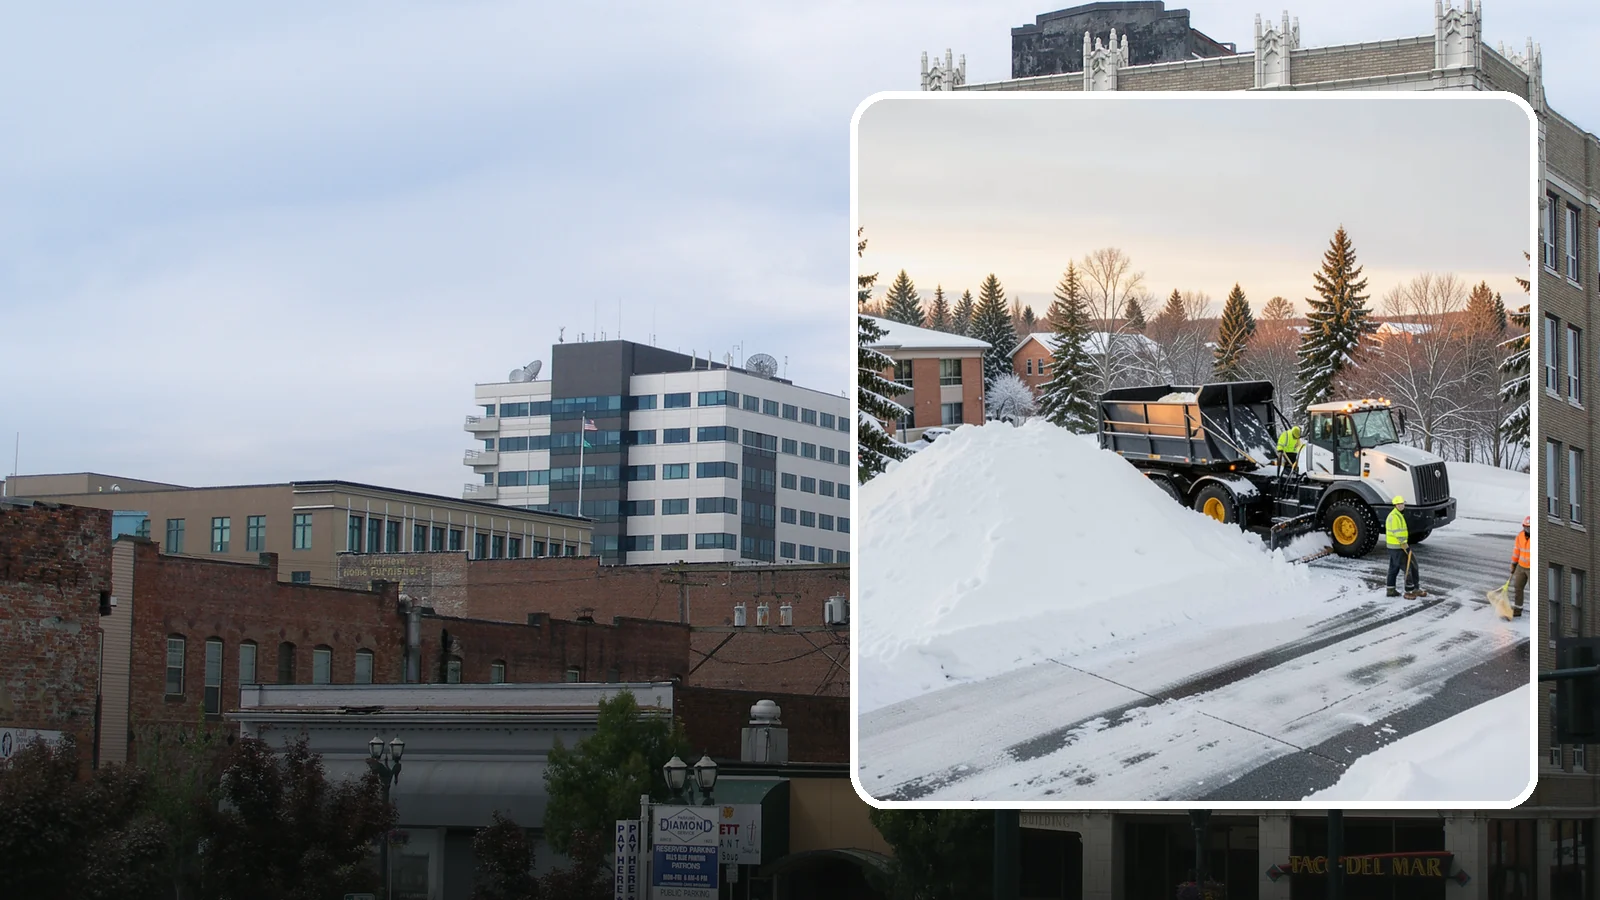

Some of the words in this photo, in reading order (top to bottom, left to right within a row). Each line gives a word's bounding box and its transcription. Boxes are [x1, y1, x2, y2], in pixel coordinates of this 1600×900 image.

[343, 568, 367, 577] Home
[370, 566, 426, 577] Furnishers
[660, 818, 713, 833] DIAMOND
[1021, 815, 1070, 828] BUILDING
[617, 825, 625, 852] PAY
[628, 824, 637, 852] PAY
[655, 845, 688, 853] RESERVED
[689, 846, 716, 854] PARKING
[721, 851, 738, 862] Soup
[1290, 855, 1329, 874] TAC
[1346, 856, 1385, 876] DEL
[1393, 857, 1442, 877] MAR
[616, 856, 625, 893] HERE
[627, 855, 636, 893] HERE
[684, 889, 710, 898] PARKING
